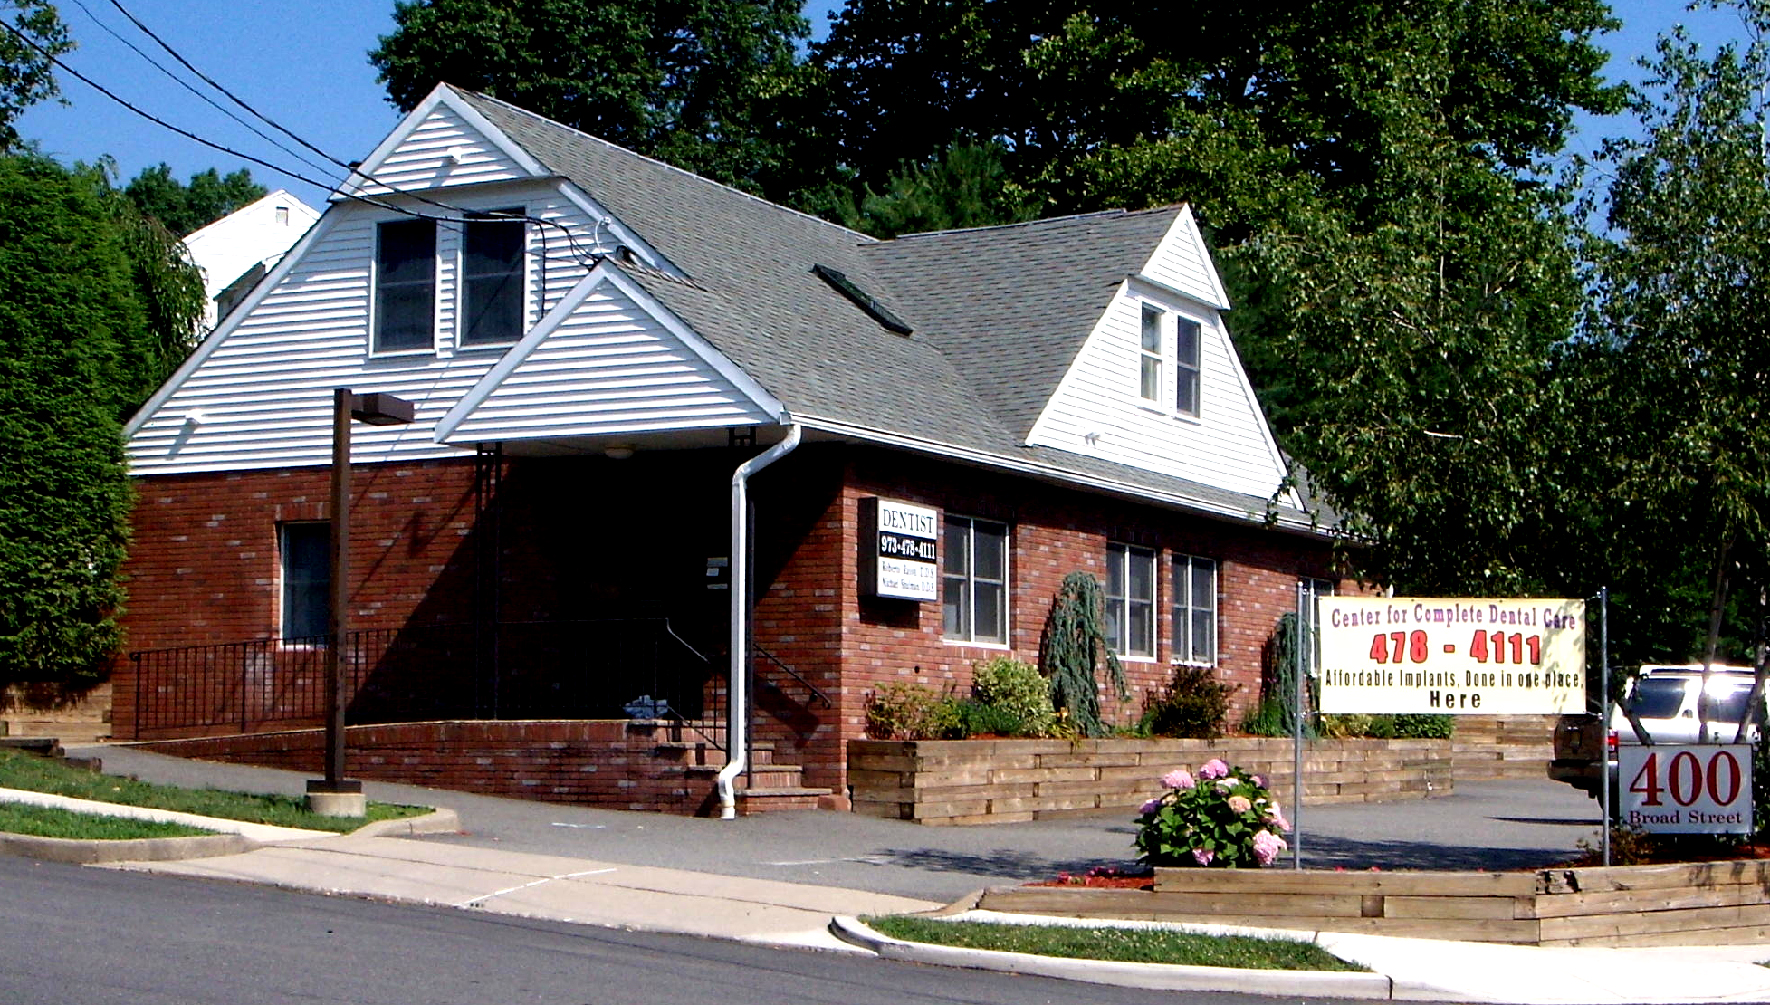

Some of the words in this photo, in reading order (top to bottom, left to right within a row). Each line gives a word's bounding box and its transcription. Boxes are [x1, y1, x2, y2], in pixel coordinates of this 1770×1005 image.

[883, 508, 934, 533] DENTIST
[1331, 608, 1380, 628] Center
[1387, 604, 1407, 624] for
[1414, 603, 1482, 628] Complete
[1489, 604, 1537, 626] Dental
[1544, 607, 1575, 629] Care
[1369, 629, 1428, 664] 478
[1469, 629, 1540, 665] 4111
[1325, 669, 1393, 686] Affordable
[1466, 670, 1495, 687] Done
[1501, 669, 1512, 687] in
[1518, 672, 1539, 688] one
[1429, 690, 1480, 708] Here
[1629, 750, 1741, 807] 400
[1630, 809, 1680, 824] Broad
[1688, 809, 1742, 824] Street
